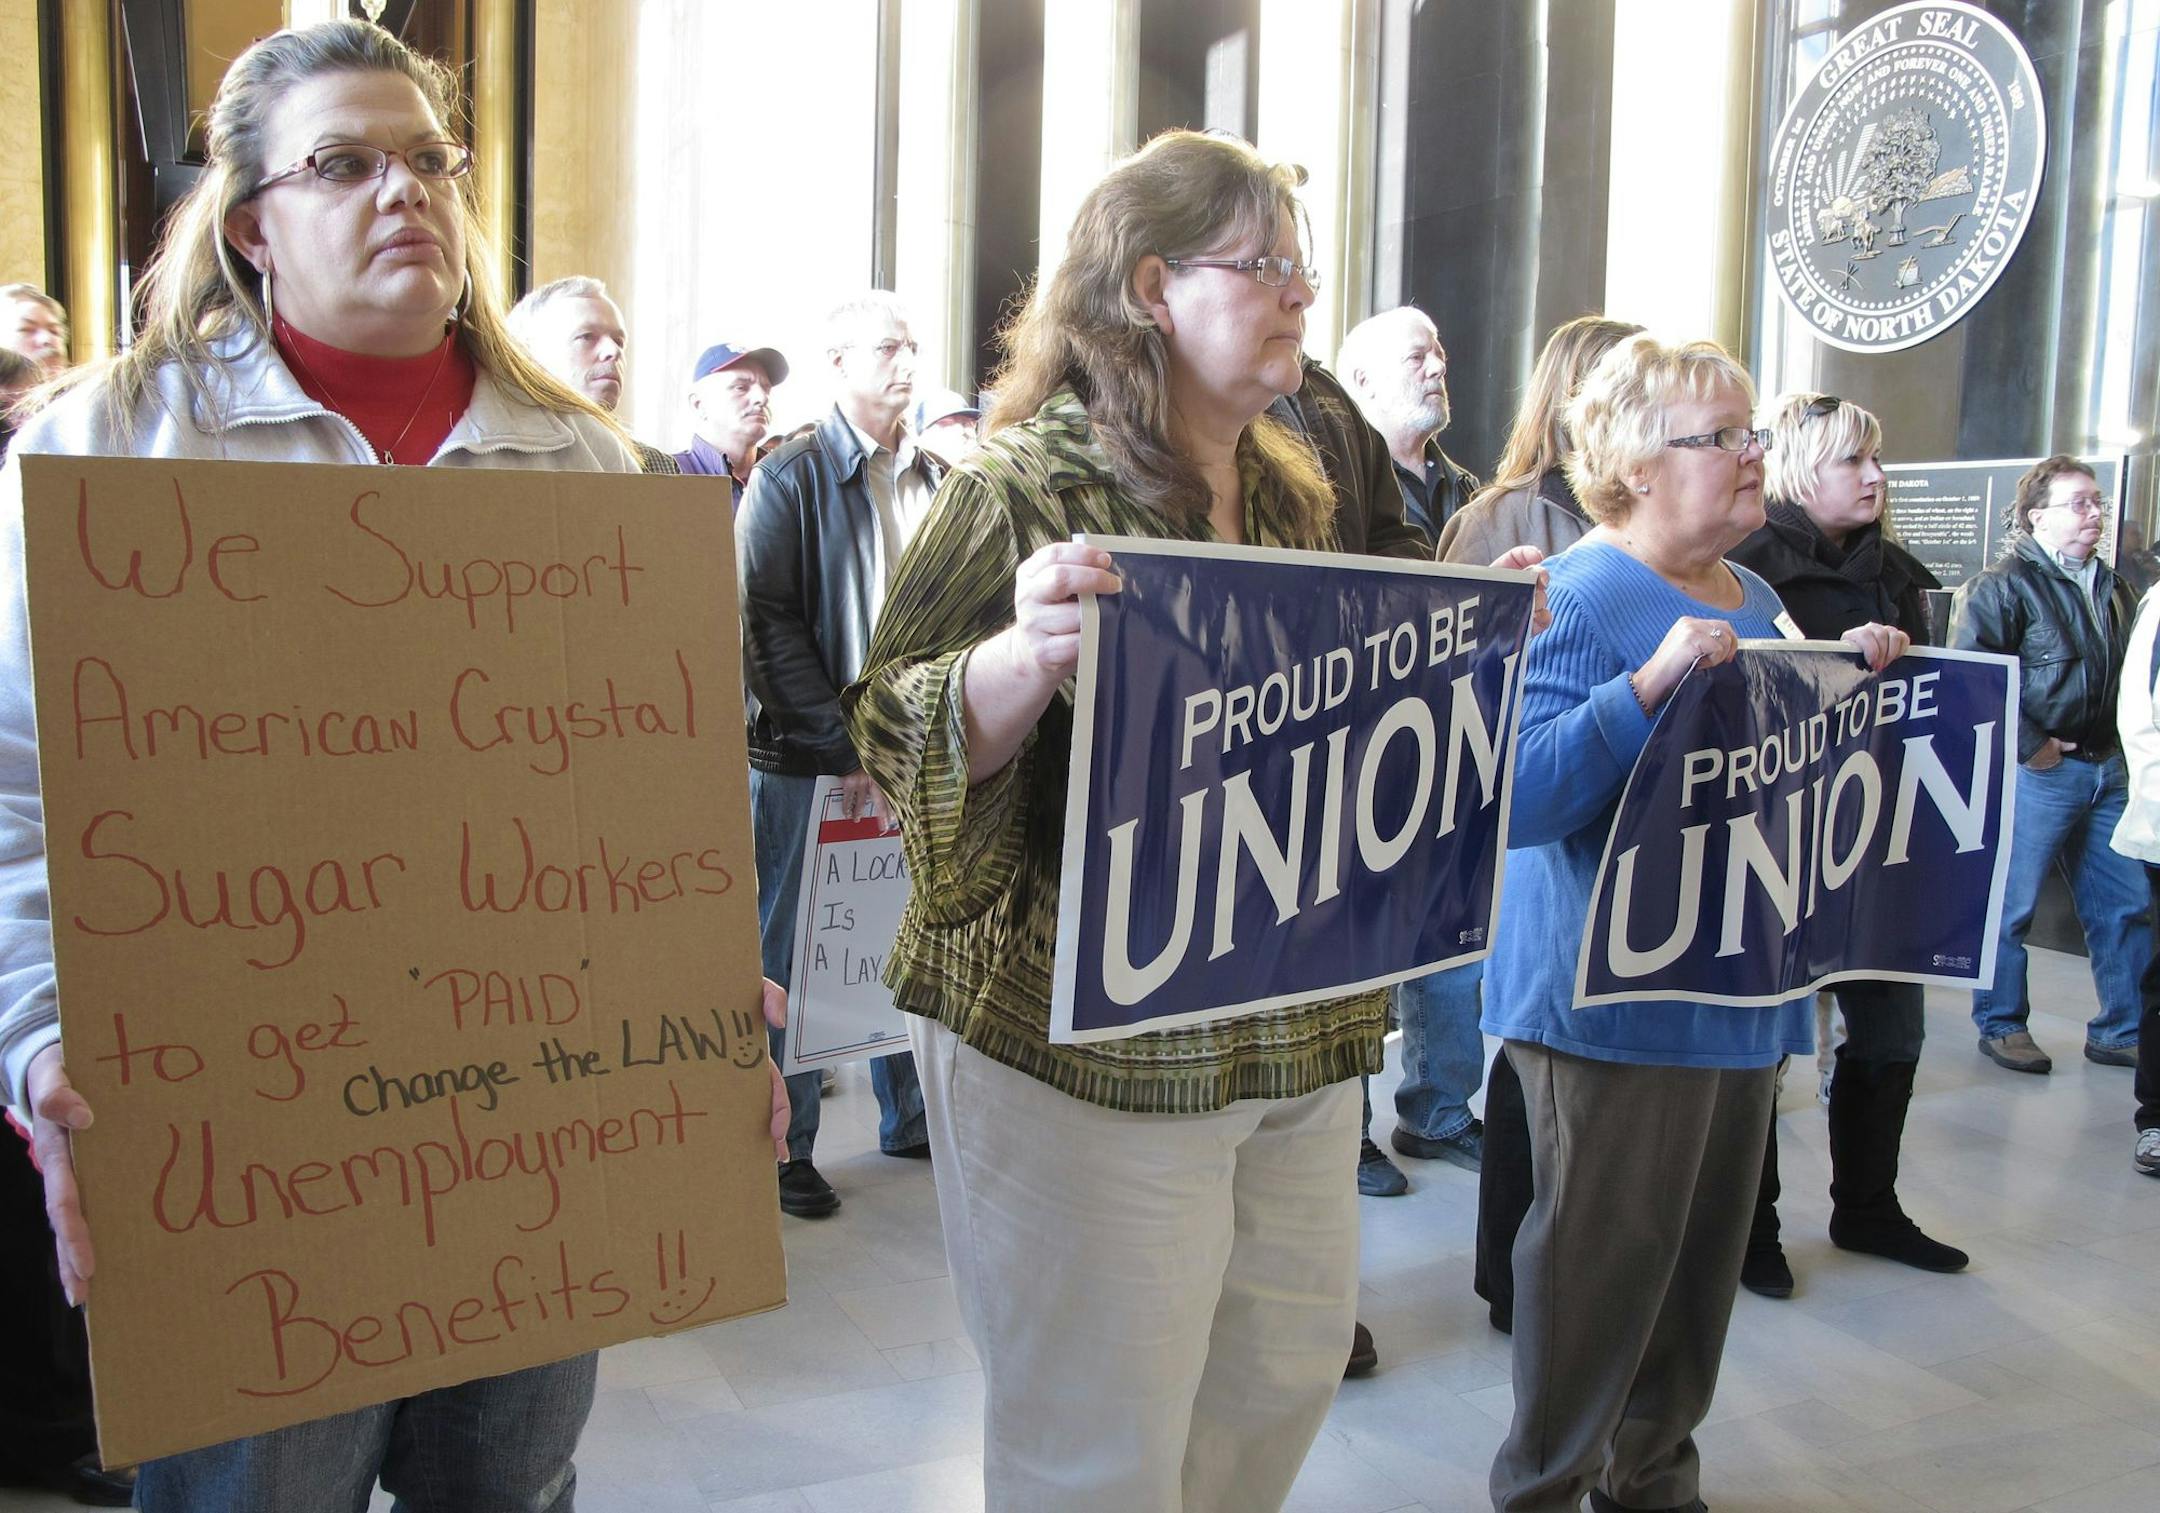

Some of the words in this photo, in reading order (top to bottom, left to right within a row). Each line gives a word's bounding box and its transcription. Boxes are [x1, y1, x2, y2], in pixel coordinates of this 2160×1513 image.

[1819, 16, 1902, 89] GREAT
[1916, 11, 1981, 50] SEAL
[1866, 65, 1891, 86] AND
[1893, 57, 1948, 75] FOREVER
[1948, 66, 1972, 90] ONE
[1838, 80, 1864, 110] NOW
[1967, 87, 1987, 114] AND
[1812, 109, 1840, 151] UNION
[1774, 138, 1797, 207] OCTOBER
[1804, 154, 1817, 184] AND
[1972, 114, 1996, 217] INSEPARABLE
[1801, 189, 1815, 246] LIBERTY
[1771, 228, 1818, 312] STATE
[1812, 301, 1844, 333] OF
[1842, 301, 1935, 342] NORTH
[1936, 189, 2027, 315] DAKOTA
[1899, 479, 1929, 488] DAKOTA
[76, 476, 269, 601] We
[324, 491, 644, 632] Support
[451, 649, 698, 776] Crystal
[1180, 646, 1354, 771] PROUD
[1364, 622, 1418, 691] TO
[1428, 595, 1480, 668] BE
[1680, 712, 1828, 809] PROUD
[1834, 691, 1868, 747] TO
[1874, 670, 1941, 727] BE
[1102, 651, 1521, 1006] UNION
[1607, 720, 1996, 979] UNION
[74, 810, 406, 970] Sugar
[461, 816, 733, 913] Workers
[827, 852, 840, 885] A
[852, 851, 908, 883] LOCK
[815, 943, 828, 971] A
[843, 947, 882, 986] LAY
[97, 1012, 205, 1086] to
[533, 1037, 610, 1085] the
[154, 1080, 708, 1247] Unemployment
